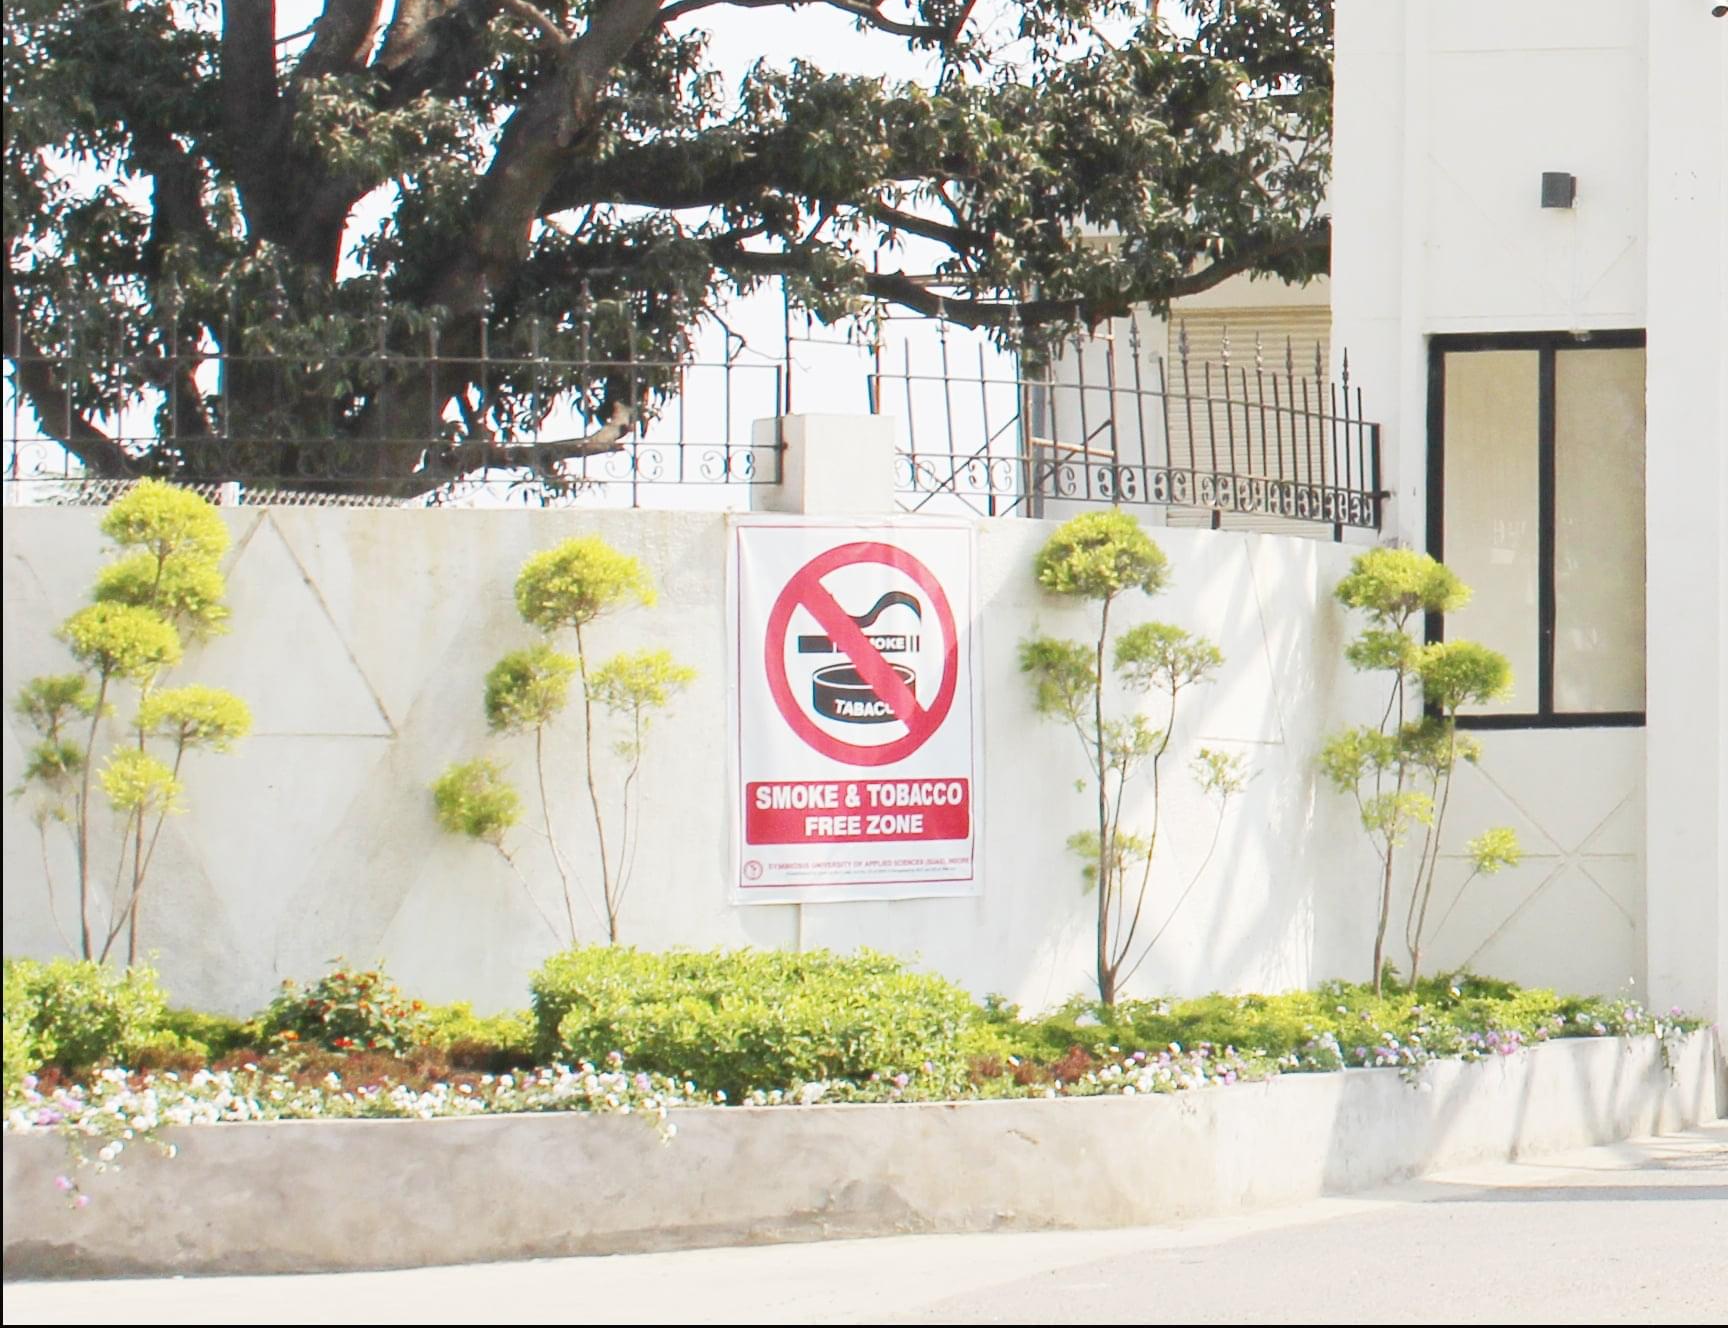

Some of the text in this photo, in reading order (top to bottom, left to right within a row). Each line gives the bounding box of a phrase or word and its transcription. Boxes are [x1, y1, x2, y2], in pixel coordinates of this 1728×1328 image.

[868, 637, 905, 650] OKE
[756, 782, 963, 810] SMOKE & TOBACCO
[805, 814, 923, 836] FREE ZONE
